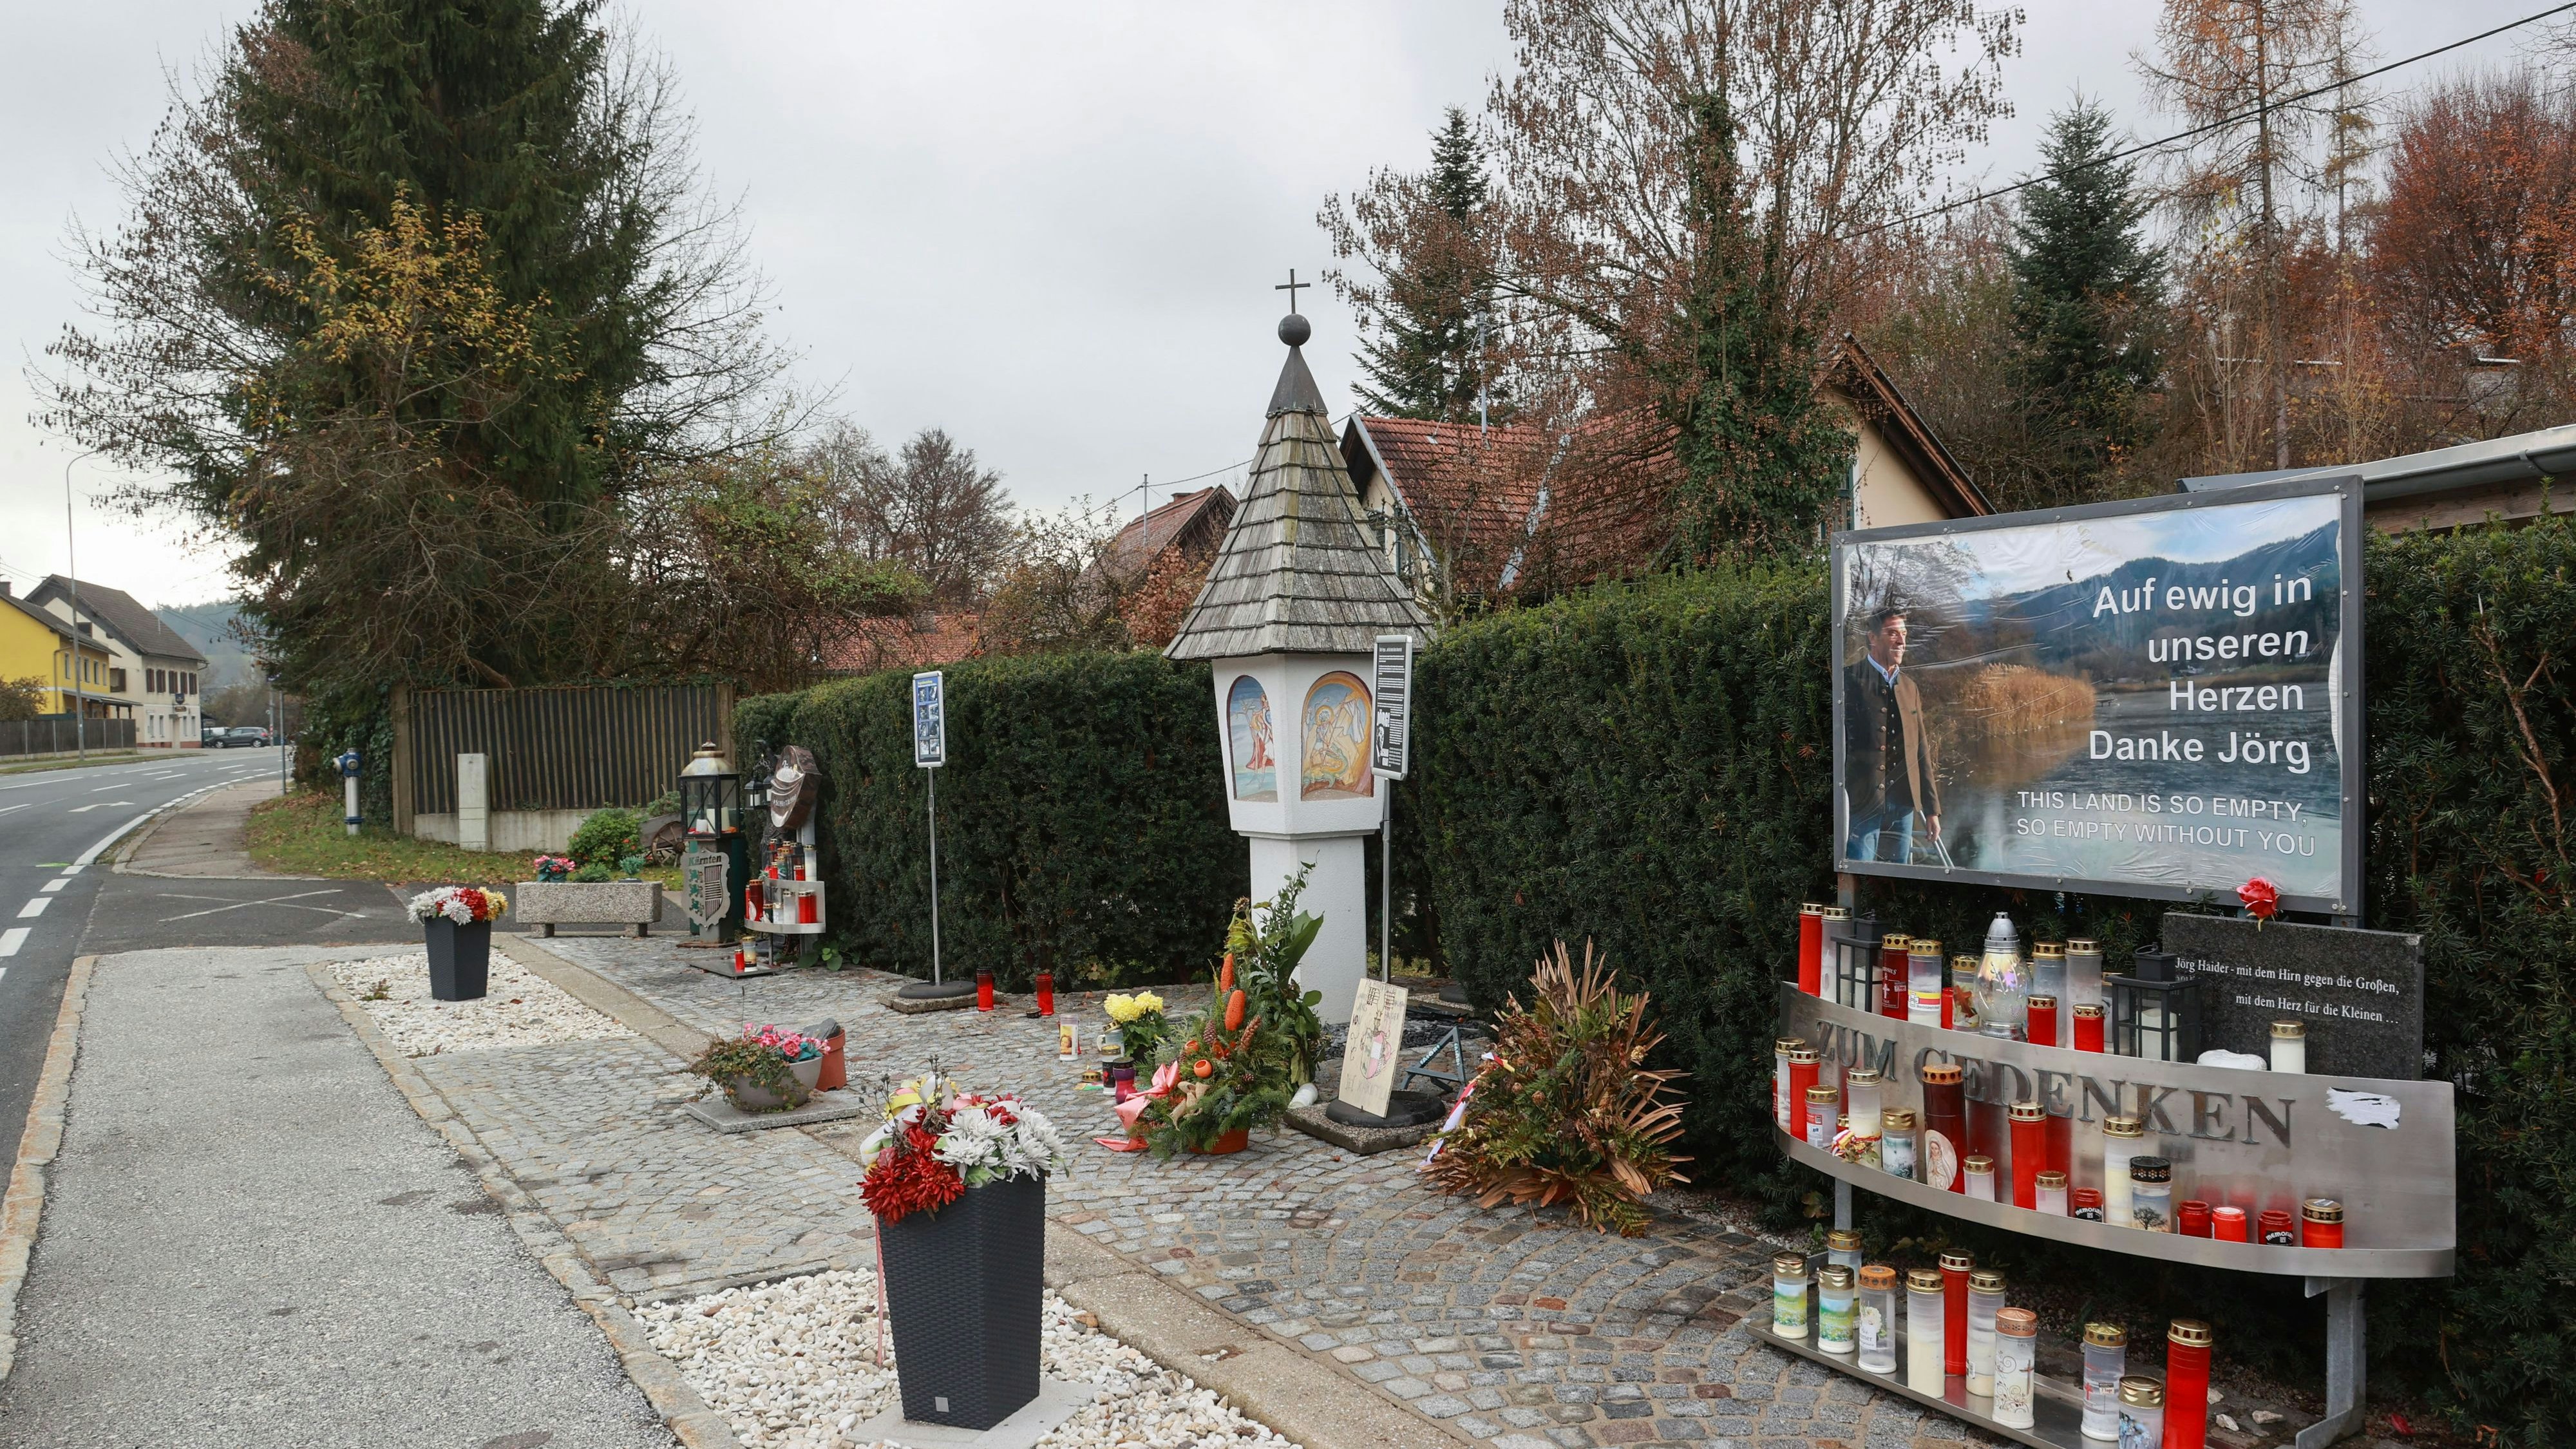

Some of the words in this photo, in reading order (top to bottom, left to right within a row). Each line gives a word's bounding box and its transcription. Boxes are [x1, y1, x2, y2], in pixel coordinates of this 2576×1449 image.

[2092, 577, 2156, 618] Auf
[2166, 578, 2256, 617] ewig
[2274, 574, 2312, 606] in
[2148, 629, 2309, 663] unseren
[2170, 681, 2304, 712] Herzen
[2090, 730, 2204, 762] Danke
[2218, 732, 2311, 774] Jörg
[2017, 791, 2064, 810] THIS
[2072, 793, 2132, 812] LAND
[2141, 795, 2161, 814] IS
[2169, 795, 2204, 815] SO
[2213, 797, 2308, 828] EMPTY,
[2016, 818, 2046, 837] SO
[2053, 820, 2127, 842] EMPTY
[2134, 824, 2249, 848] WITHOUT
[2257, 829, 2316, 857] YOU
[2175, 957, 2195, 973] Jörg
[2197, 959, 2229, 974] Haider
[2236, 964, 2253, 977] mit
[2255, 965, 2276, 980] dem
[2278, 969, 2302, 983] Hirn
[2304, 974, 2334, 989] gegen
[2336, 973, 2353, 989] die
[2355, 976, 2400, 996] Großen,
[2236, 994, 2252, 1006] mit
[2254, 995, 2275, 1009] dem
[2277, 997, 2302, 1012] Herz
[2304, 1000, 2320, 1014] für
[2323, 1003, 2339, 1017] die
[2341, 1005, 2383, 1023] Kleinen
[1815, 1018, 1898, 1083] ZUM
[1913, 1046, 2297, 1149] GEDENKEN
